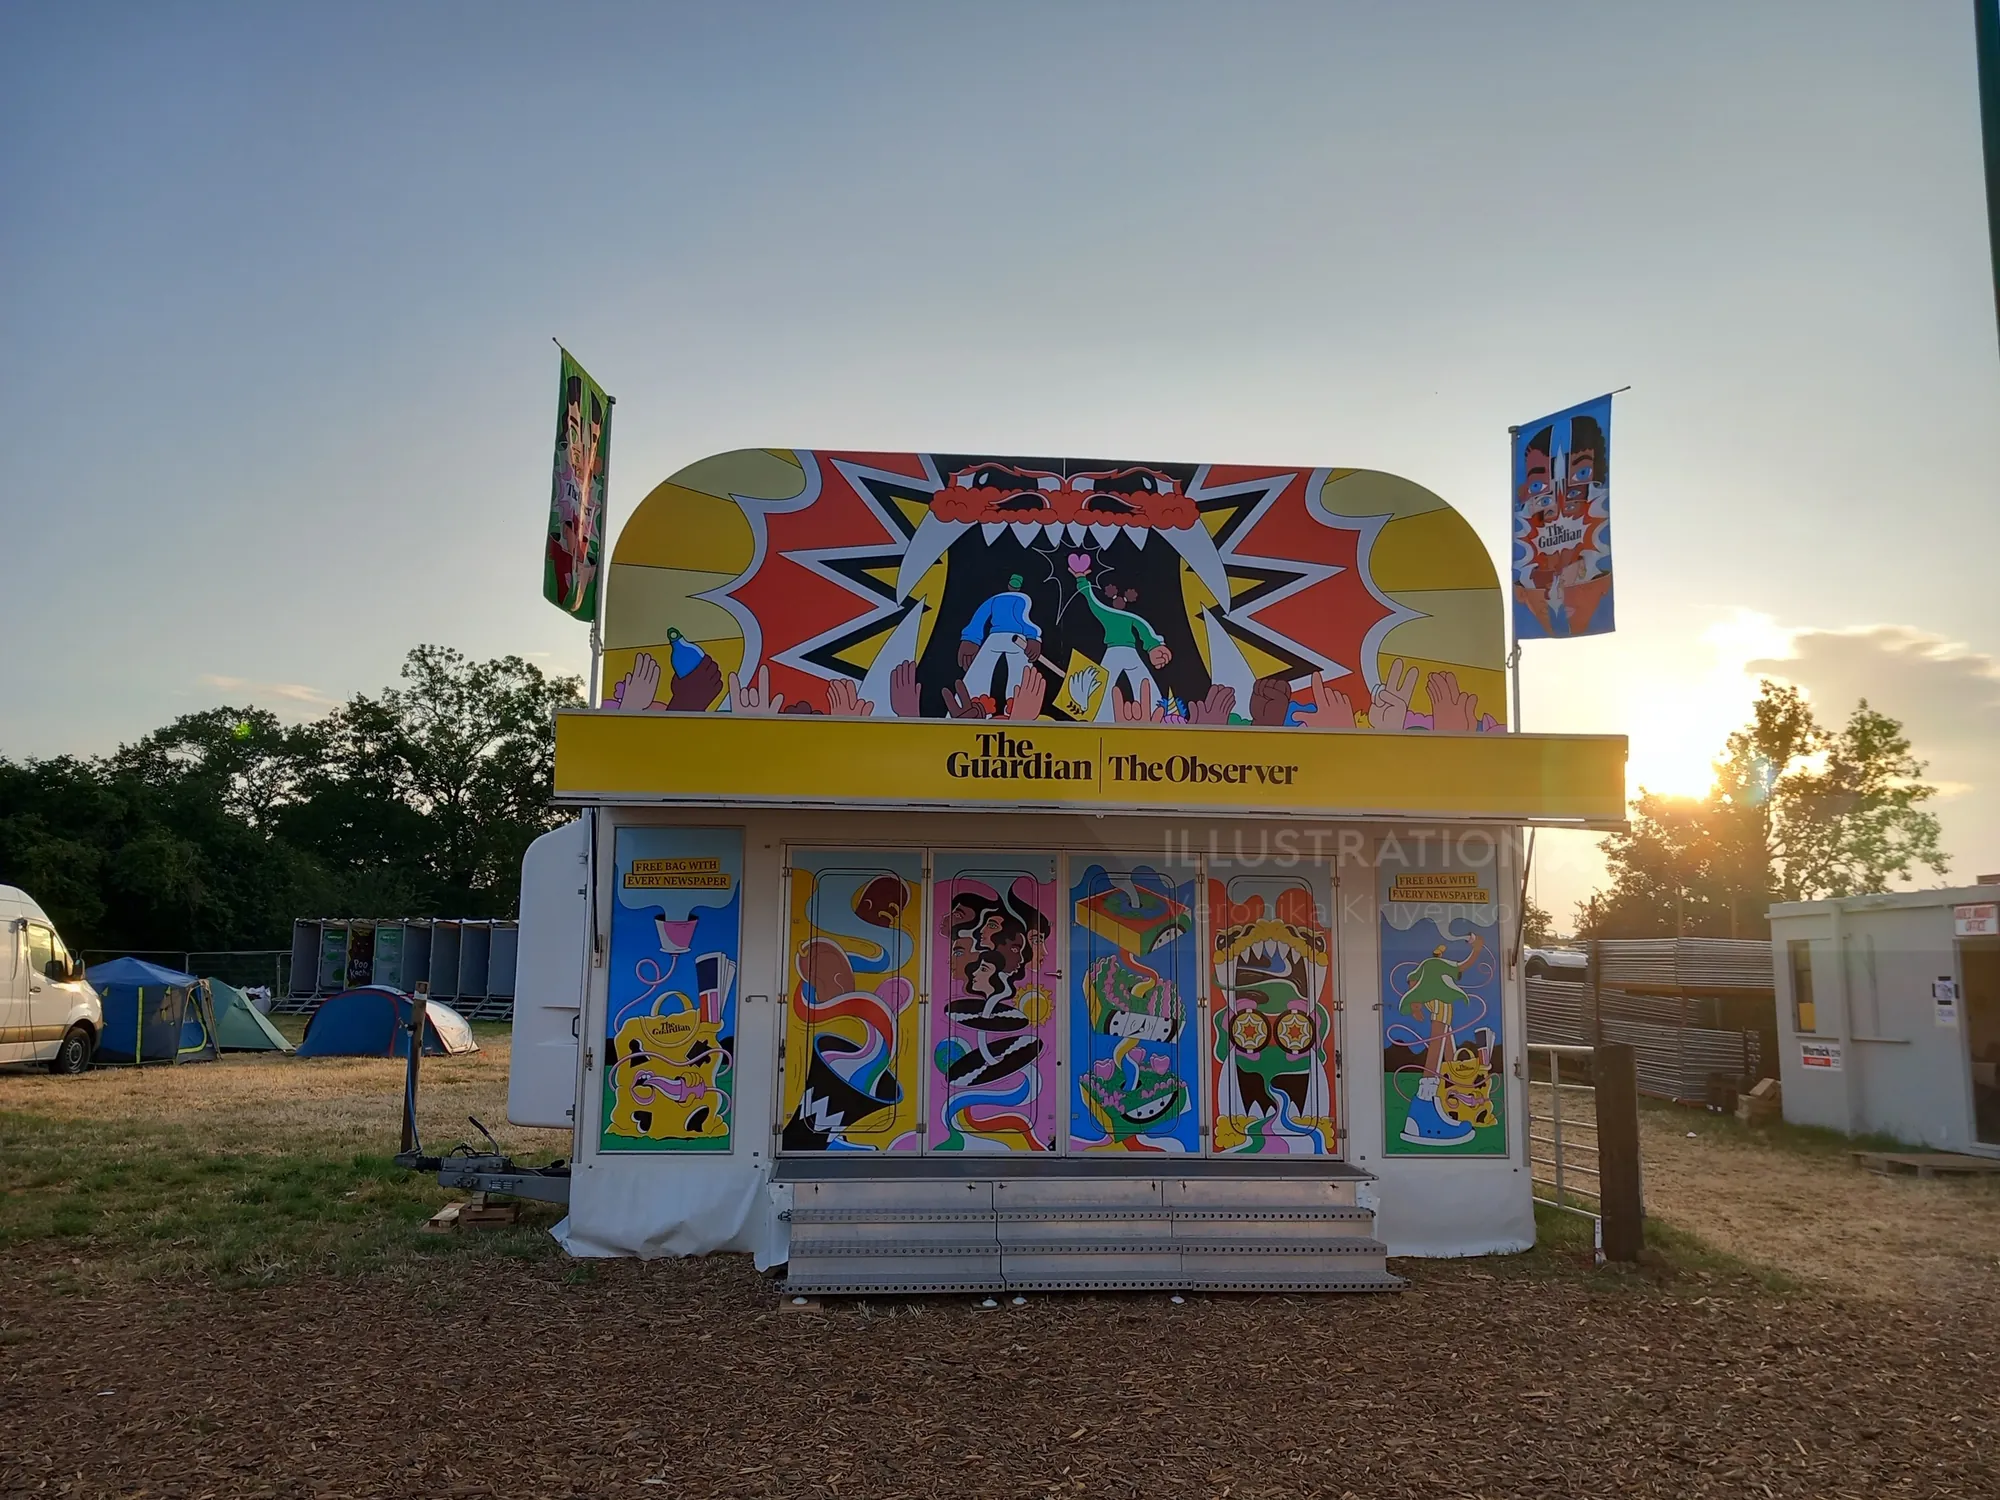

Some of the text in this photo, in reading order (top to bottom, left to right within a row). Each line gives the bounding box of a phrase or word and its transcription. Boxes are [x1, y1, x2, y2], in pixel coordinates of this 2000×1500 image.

[1545, 523, 1564, 536] The
[1538, 529, 1582, 548] Guardian
[975, 731, 1034, 758] The
[946, 751, 1092, 780] Guardian
[635, 860, 717, 871] FREE BAG WITH
[627, 876, 727, 886] EVERY NEWSPAPER
[1399, 875, 1475, 885] FREE BAG WITH
[1393, 889, 1486, 900] EVERY NEWSPAPER
